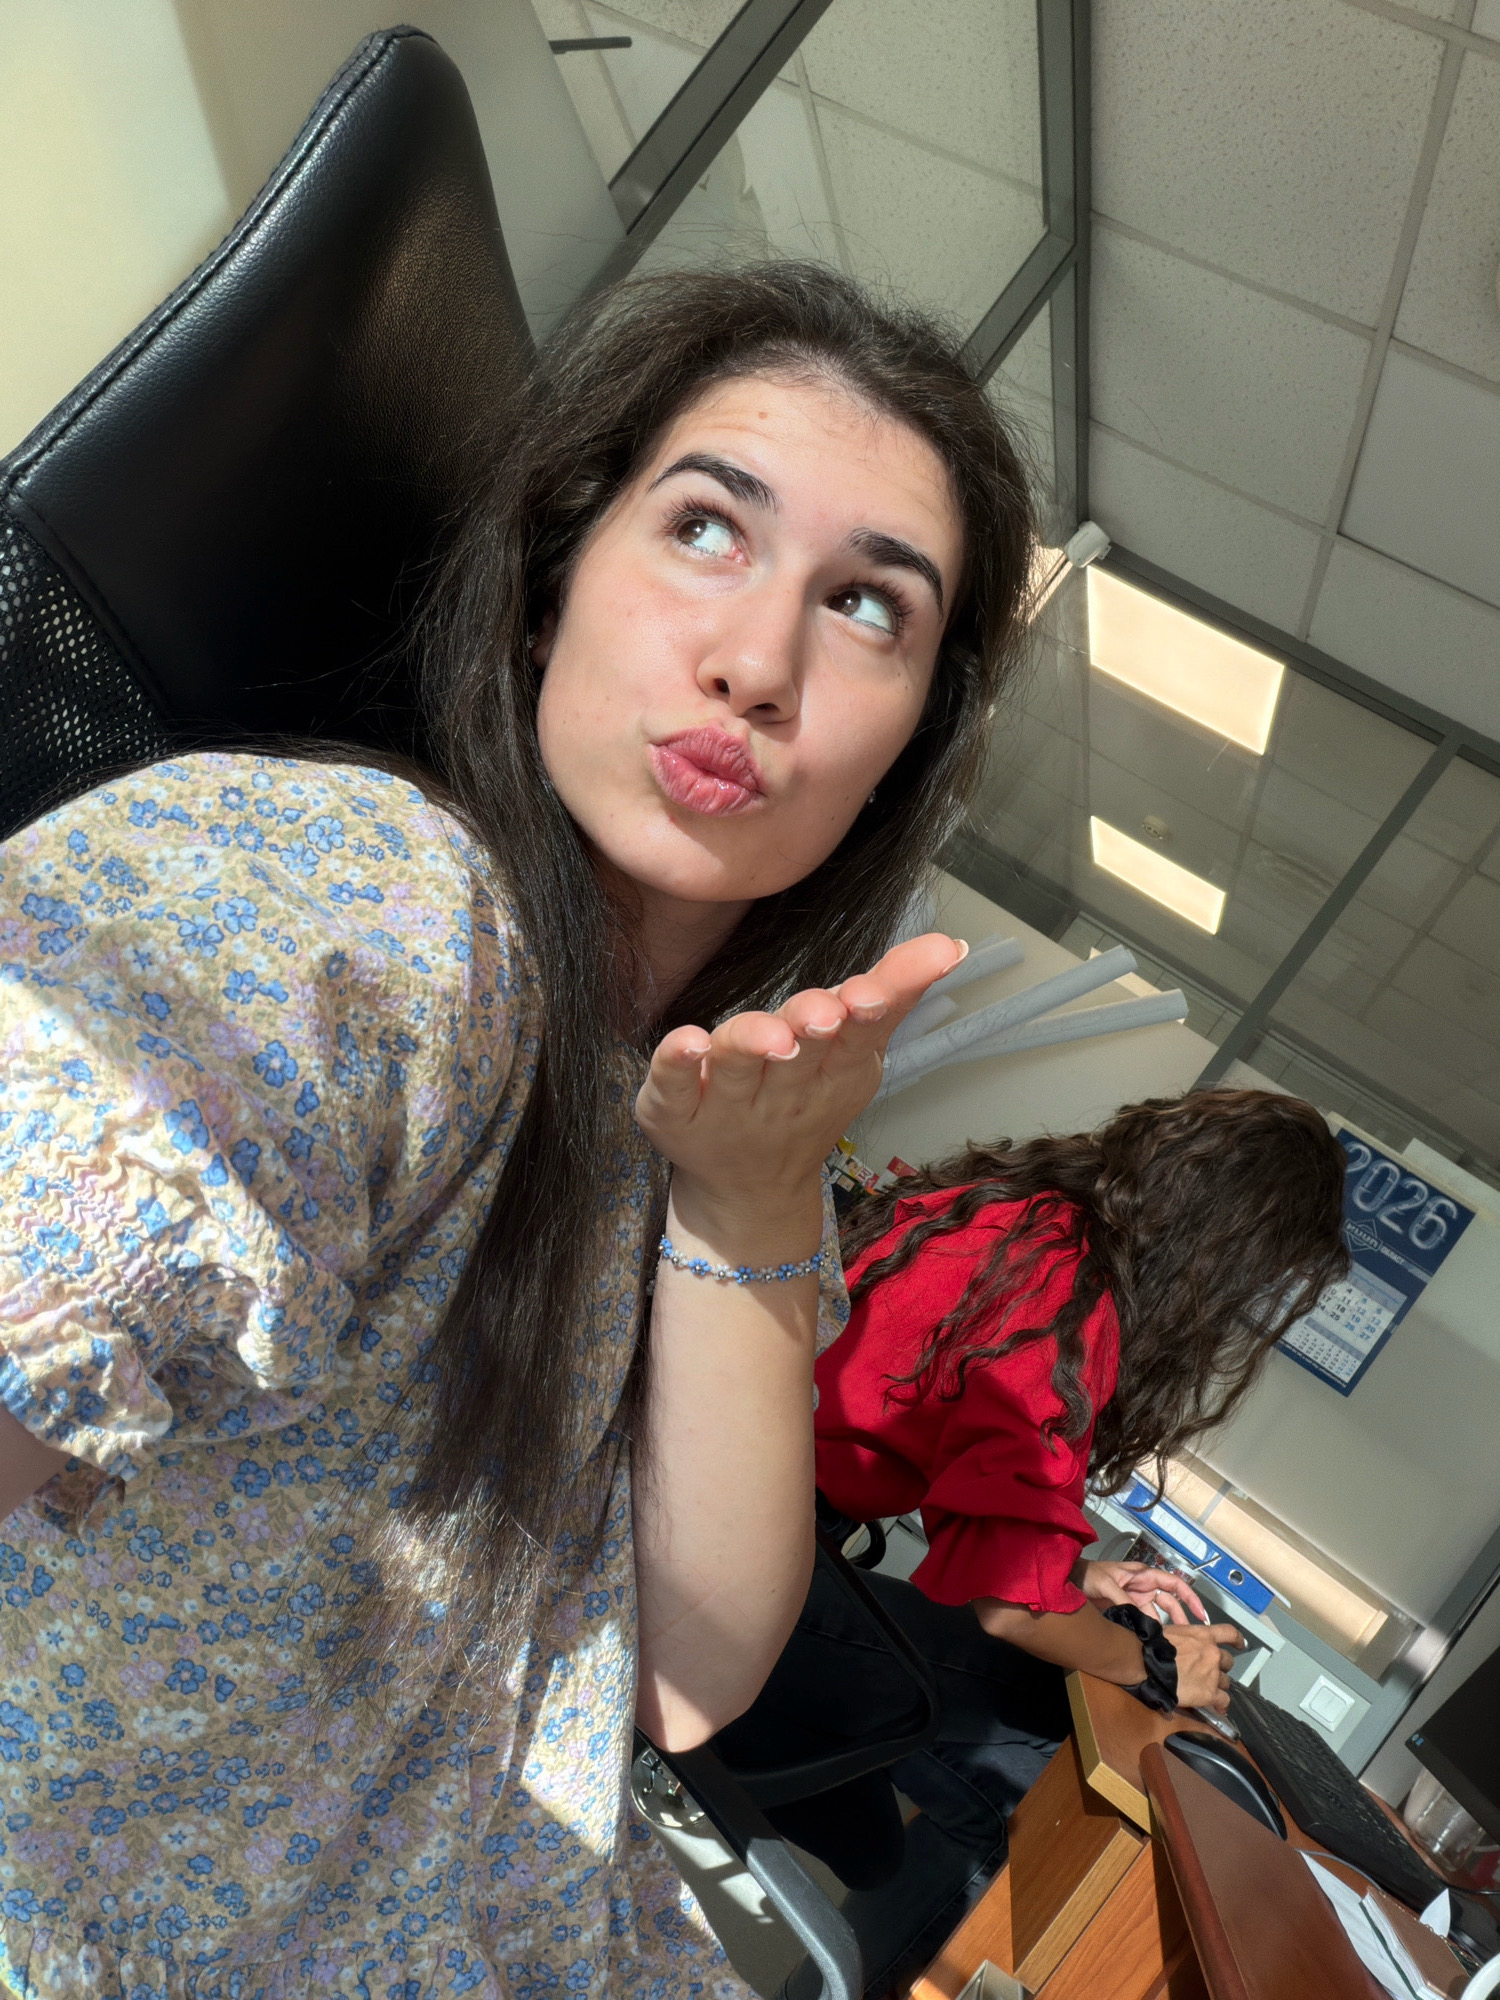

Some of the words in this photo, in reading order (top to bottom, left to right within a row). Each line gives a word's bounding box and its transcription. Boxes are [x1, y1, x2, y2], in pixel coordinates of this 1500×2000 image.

[1344, 1141, 1457, 1249] 2026
[1330, 1311, 1341, 1320] 25
[1359, 1331, 1371, 1340] 27
